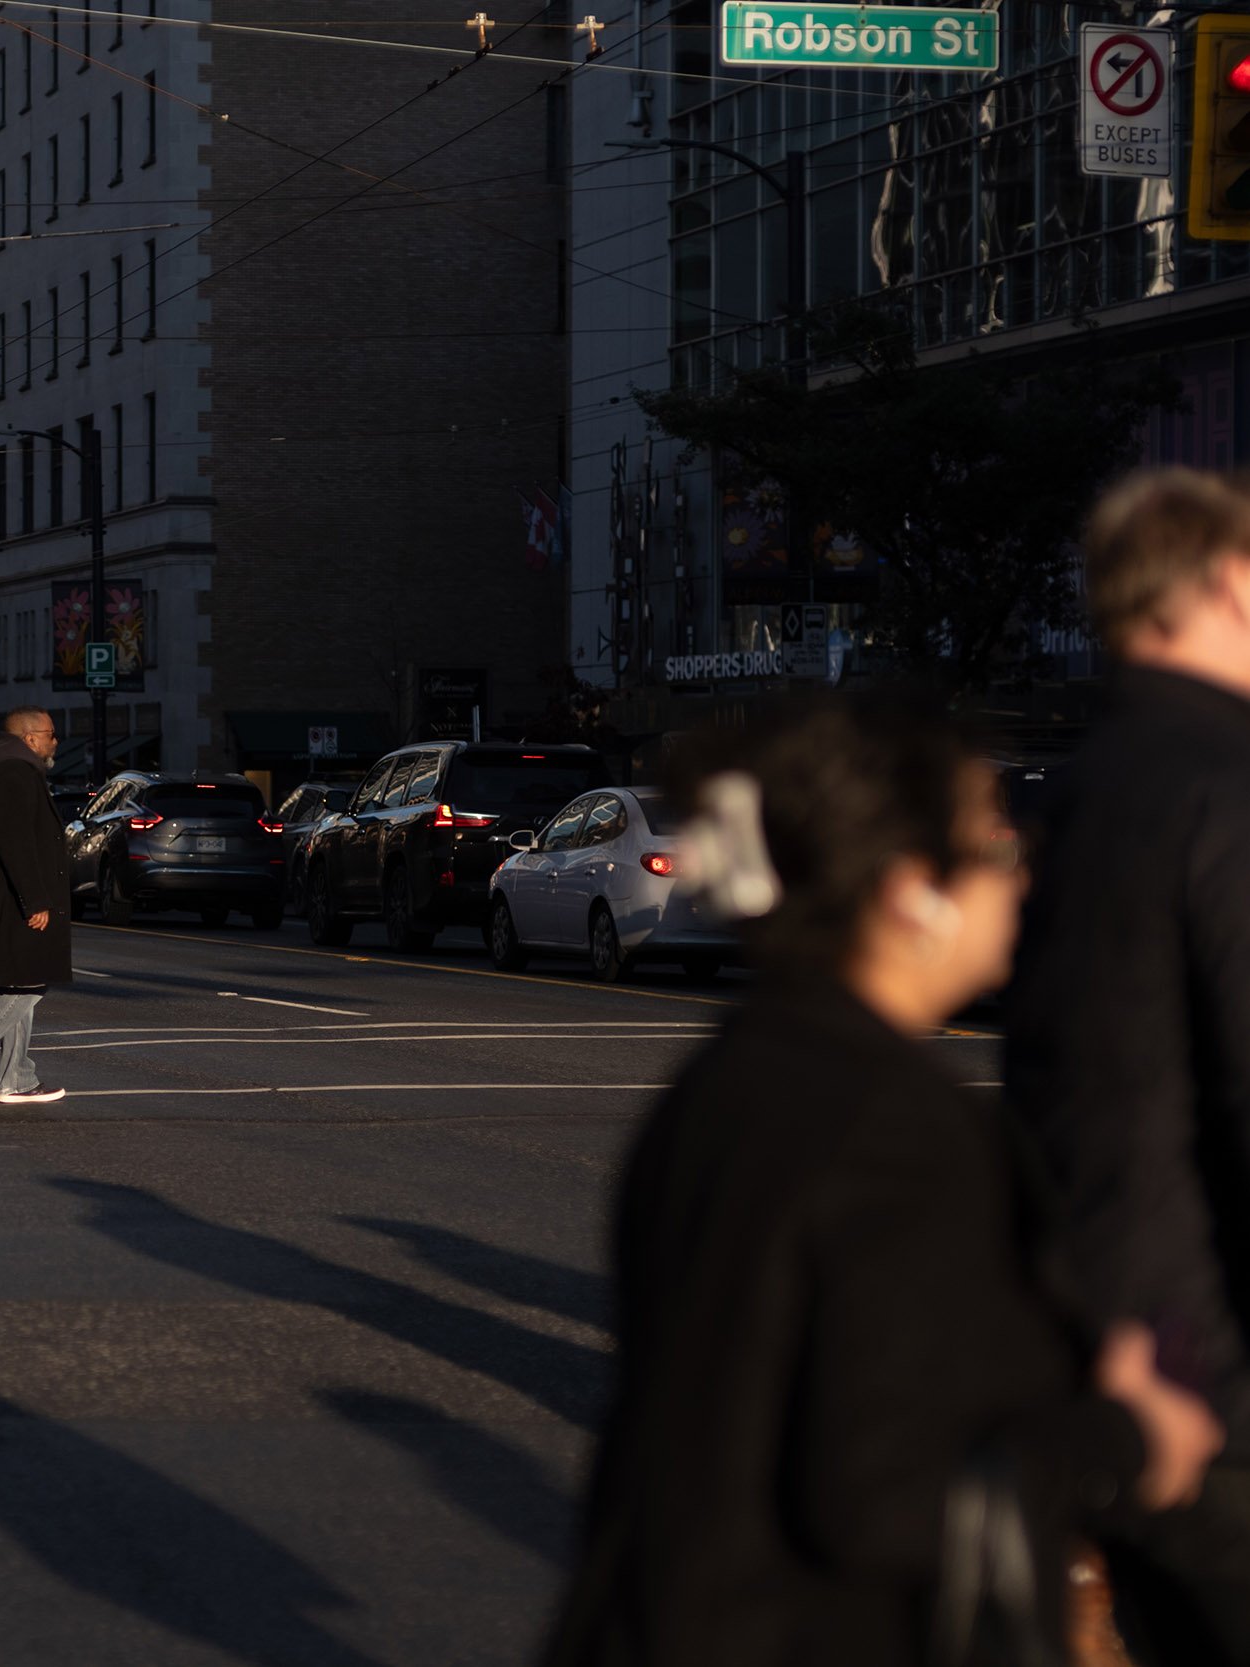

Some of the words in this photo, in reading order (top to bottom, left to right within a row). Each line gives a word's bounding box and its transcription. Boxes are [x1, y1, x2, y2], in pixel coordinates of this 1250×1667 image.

[744, 11, 912, 54] Robson
[933, 17, 979, 56] St
[1095, 124, 1161, 144] EXCEPT
[1098, 145, 1158, 165] BUSES
[91, 647, 110, 671] P
[665, 652, 745, 681] SHOPPERS
[744, 650, 782, 676] DRUG
